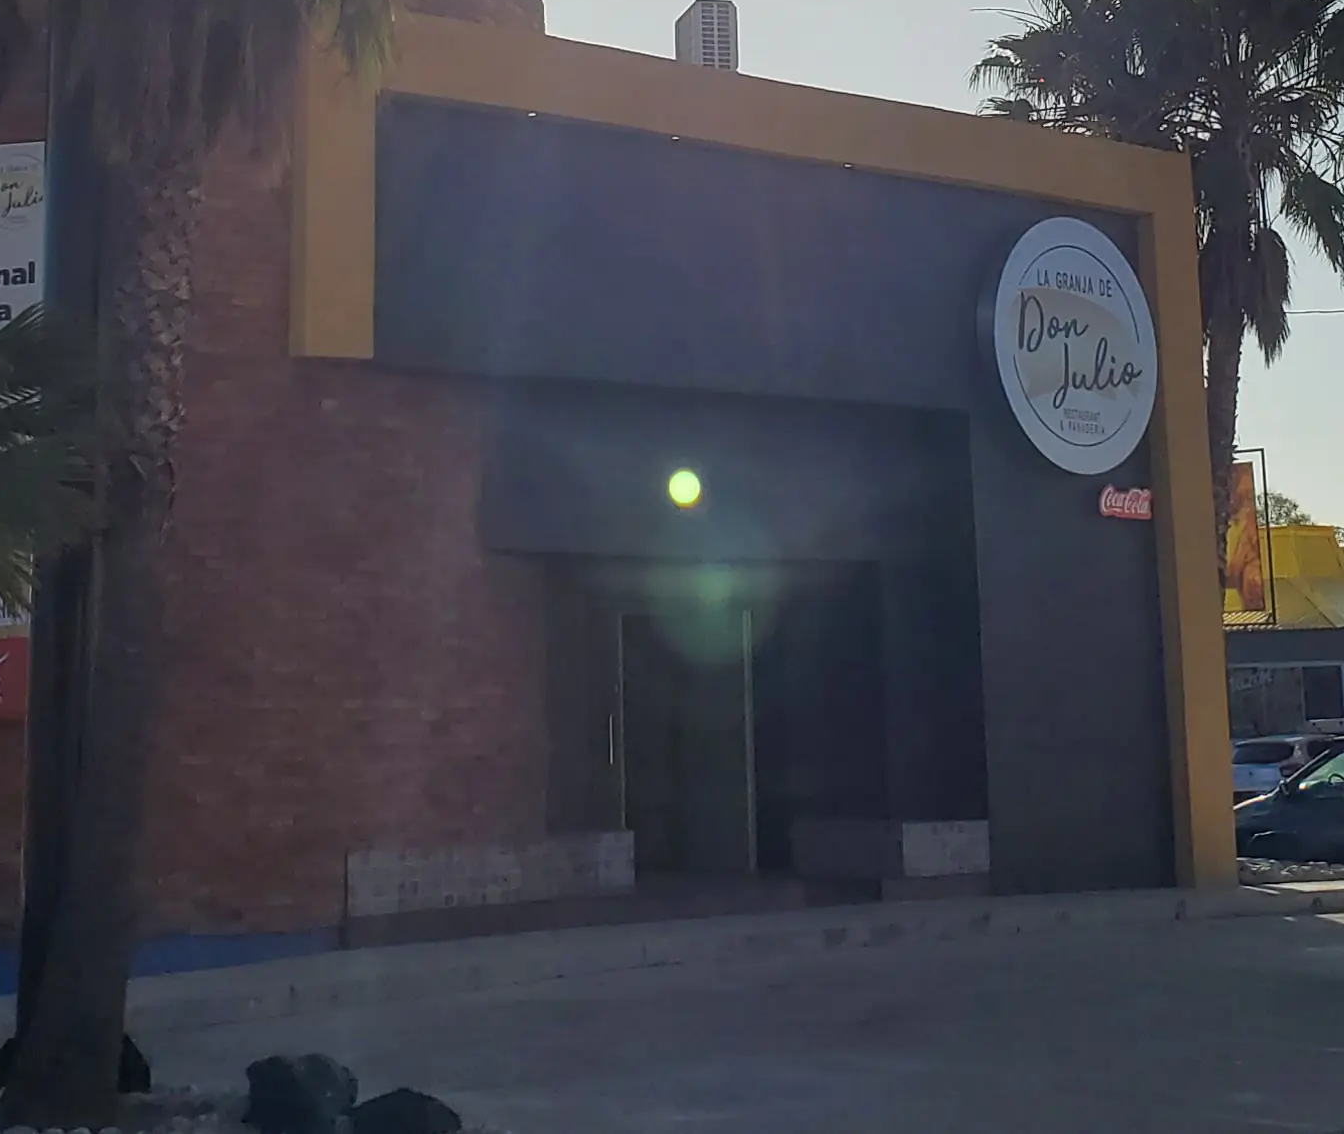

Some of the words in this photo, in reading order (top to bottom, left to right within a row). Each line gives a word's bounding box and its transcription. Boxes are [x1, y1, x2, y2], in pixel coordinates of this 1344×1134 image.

[1036, 268, 1050, 287] LA
[1055, 271, 1094, 295] GRANJA
[1099, 278, 1113, 298] DE
[1017, 290, 1089, 352] Don
[1051, 336, 1143, 410] Julio
